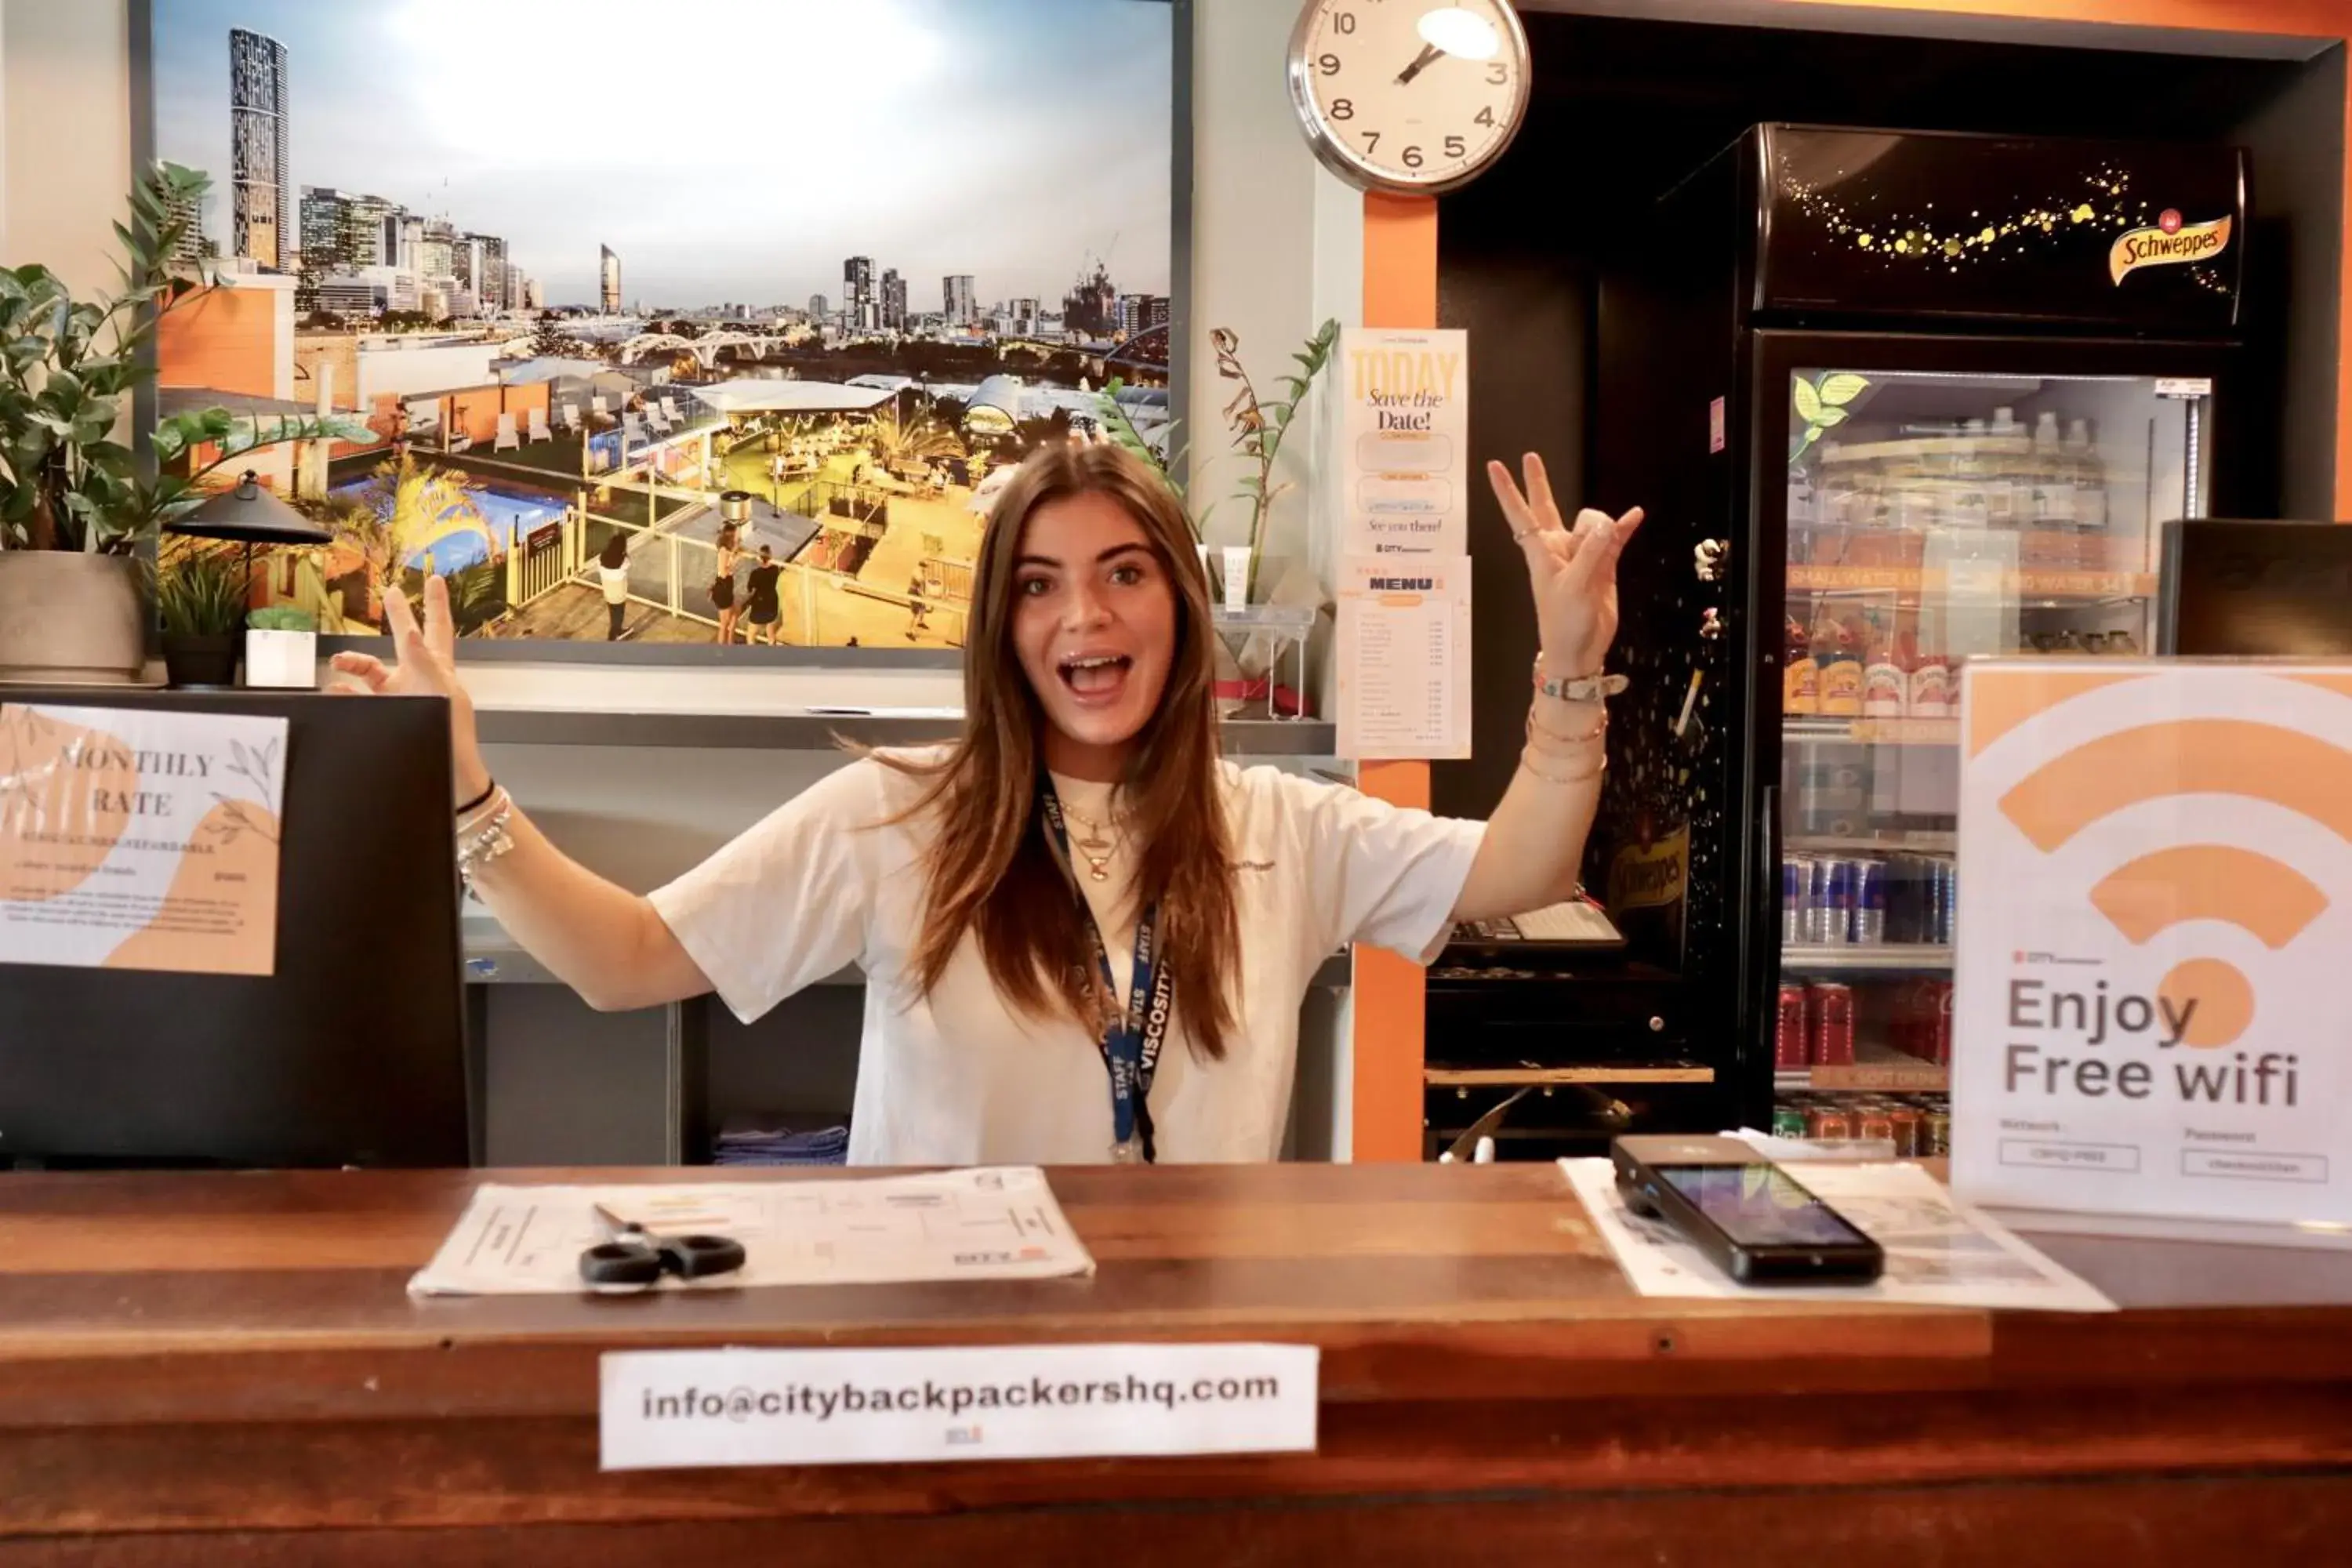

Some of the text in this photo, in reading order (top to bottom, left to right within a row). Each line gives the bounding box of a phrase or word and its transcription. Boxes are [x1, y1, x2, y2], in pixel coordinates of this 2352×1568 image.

[1334, 13, 1356, 34] 10
[1319, 54, 1341, 75] 9
[1485, 63, 1508, 85] 3
[1330, 99, 1354, 120] 8
[1474, 106, 1494, 128] 4
[1361, 132, 1381, 154] 7
[1444, 136, 1465, 158] 5
[1402, 146, 1423, 168] 6
[2122, 230, 2218, 264] Schweppes
[1351, 348, 1459, 401] TODAY
[1367, 388, 1443, 408] Save the
[1378, 411, 1431, 430] Date!
[1370, 577, 1432, 590] MENU
[59, 746, 213, 777] MONTHLY
[93, 788, 172, 816] RATE
[2008, 978, 2200, 1048] Enjoy
[1112, 1055, 1128, 1100] STAFF
[2004, 1044, 2299, 1107] Free wifi
[643, 1374, 1279, 1423] info@citybackpackershq.com
